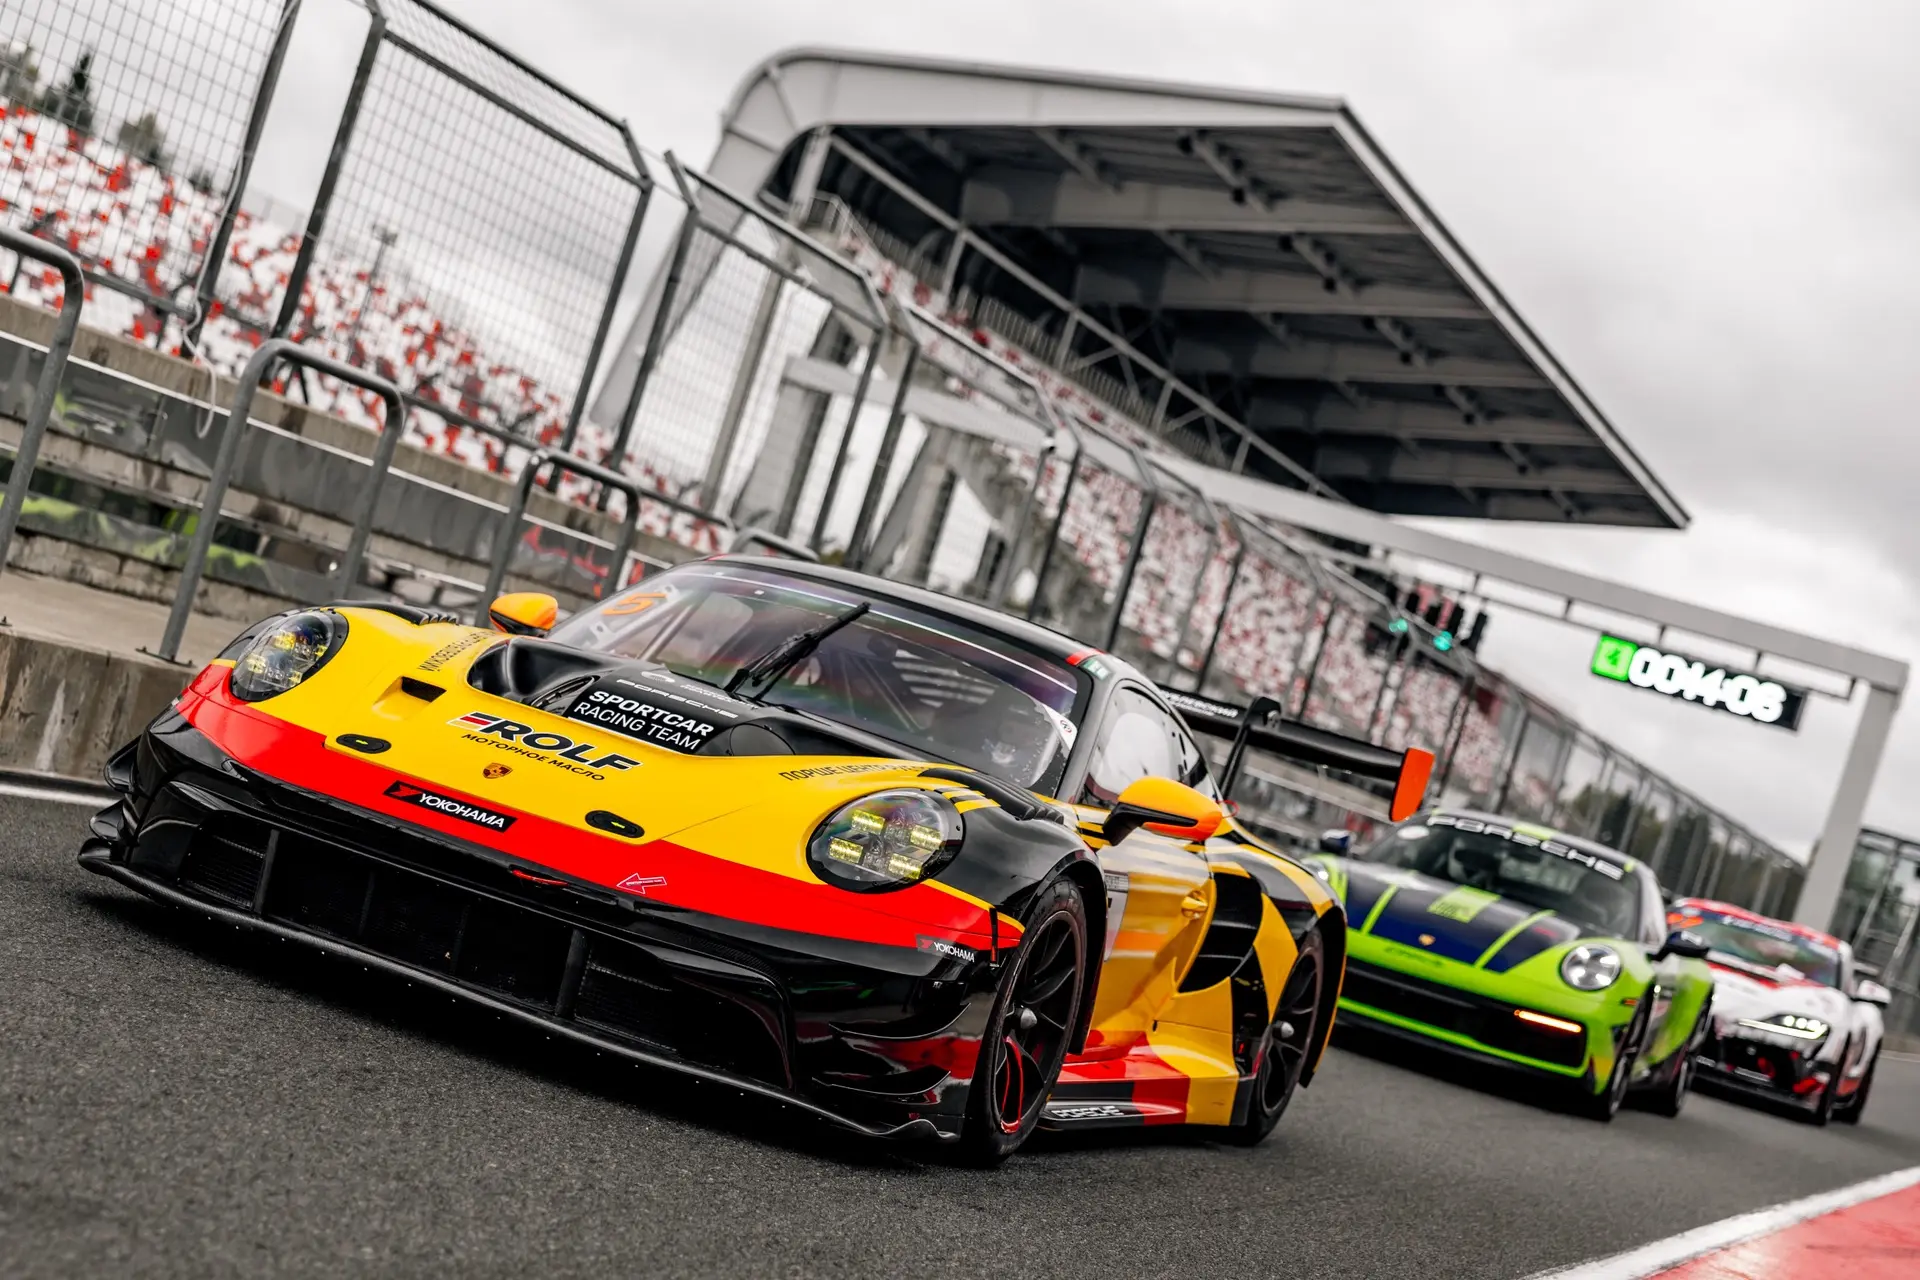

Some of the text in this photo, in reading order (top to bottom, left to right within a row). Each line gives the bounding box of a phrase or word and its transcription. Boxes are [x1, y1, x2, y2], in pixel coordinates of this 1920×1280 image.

[601, 592, 667, 616] 5
[589, 690, 715, 740] SPORTCAR
[616, 679, 739, 719] PORSCHE
[480, 719, 642, 771] ROLF
[573, 701, 702, 752] RACING TEAM
[461, 733, 606, 781] МОТОРНОЕ МАСЛО
[778, 765, 842, 781] ПОРШЕ
[417, 791, 506, 829] YOKOHAMA
[1426, 814, 1625, 881] PORSCHE
[933, 941, 975, 962] YOKOHAMA
